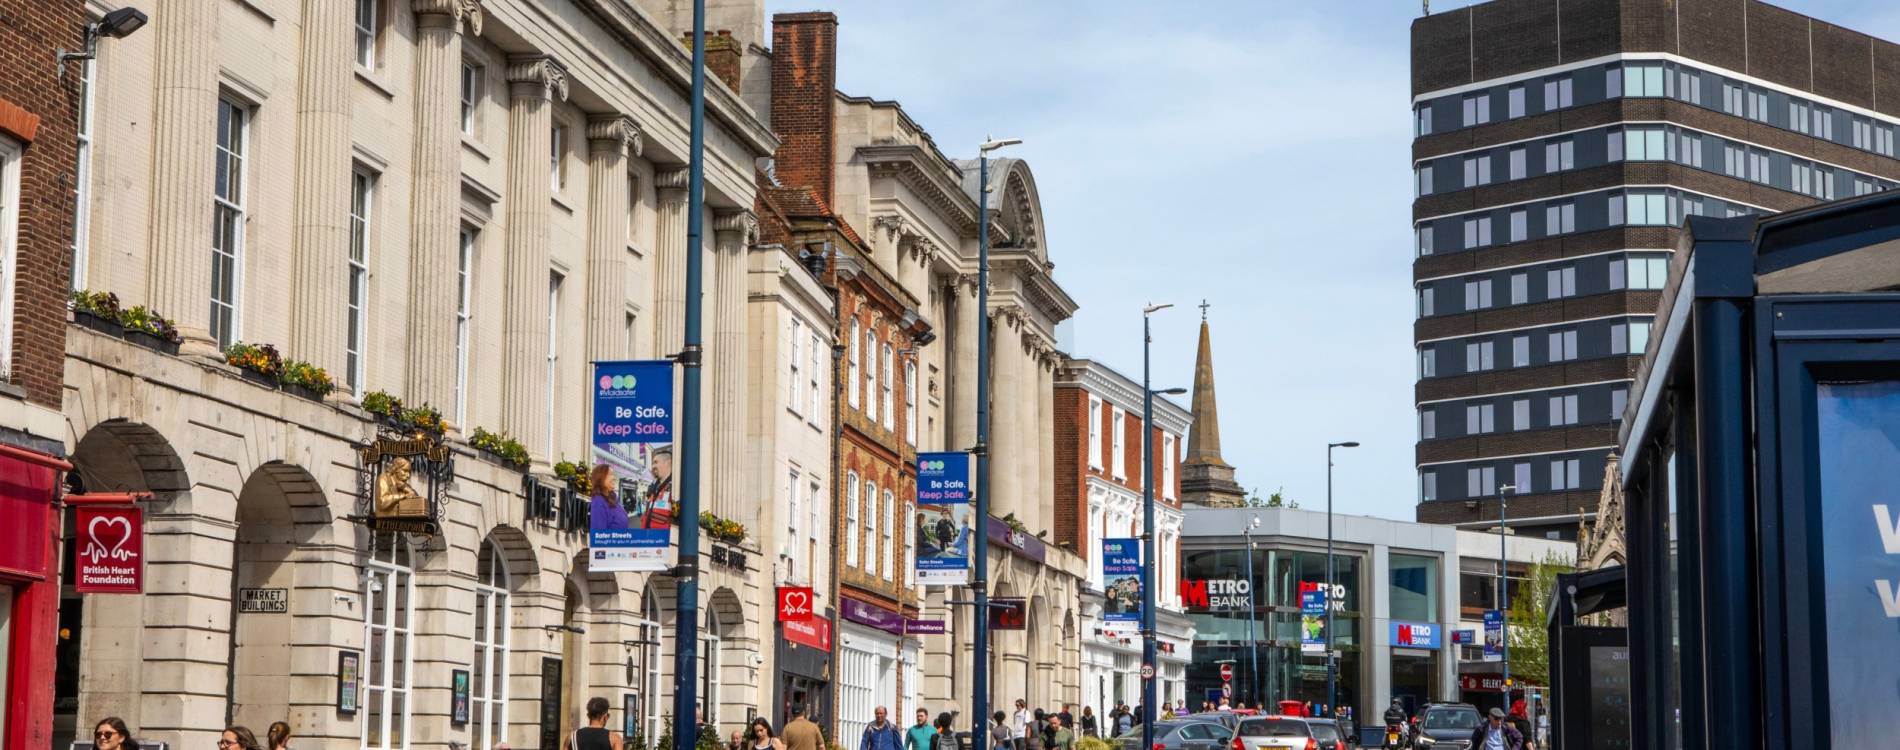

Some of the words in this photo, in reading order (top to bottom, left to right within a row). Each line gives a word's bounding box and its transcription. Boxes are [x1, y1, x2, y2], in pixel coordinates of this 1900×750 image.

[616, 407, 632, 418] Be
[636, 405, 669, 418] Safe.
[598, 423, 631, 437] Keep
[635, 422, 669, 434] Safe.
[931, 480, 942, 488] Be
[944, 480, 966, 488] Safe.
[920, 491, 942, 500] Keep
[944, 490, 966, 498] Safe.
[83, 566, 109, 574] British
[111, 566, 135, 574] Heart
[83, 575, 135, 584] Foundation
[247, 591, 281, 600] MARKET
[1181, 579, 1249, 608] METRO
[242, 601, 285, 610] BUILDINGS
[1210, 597, 1250, 607] BANK
[1398, 624, 1432, 645] METRO
[1411, 637, 1432, 645] BANK
